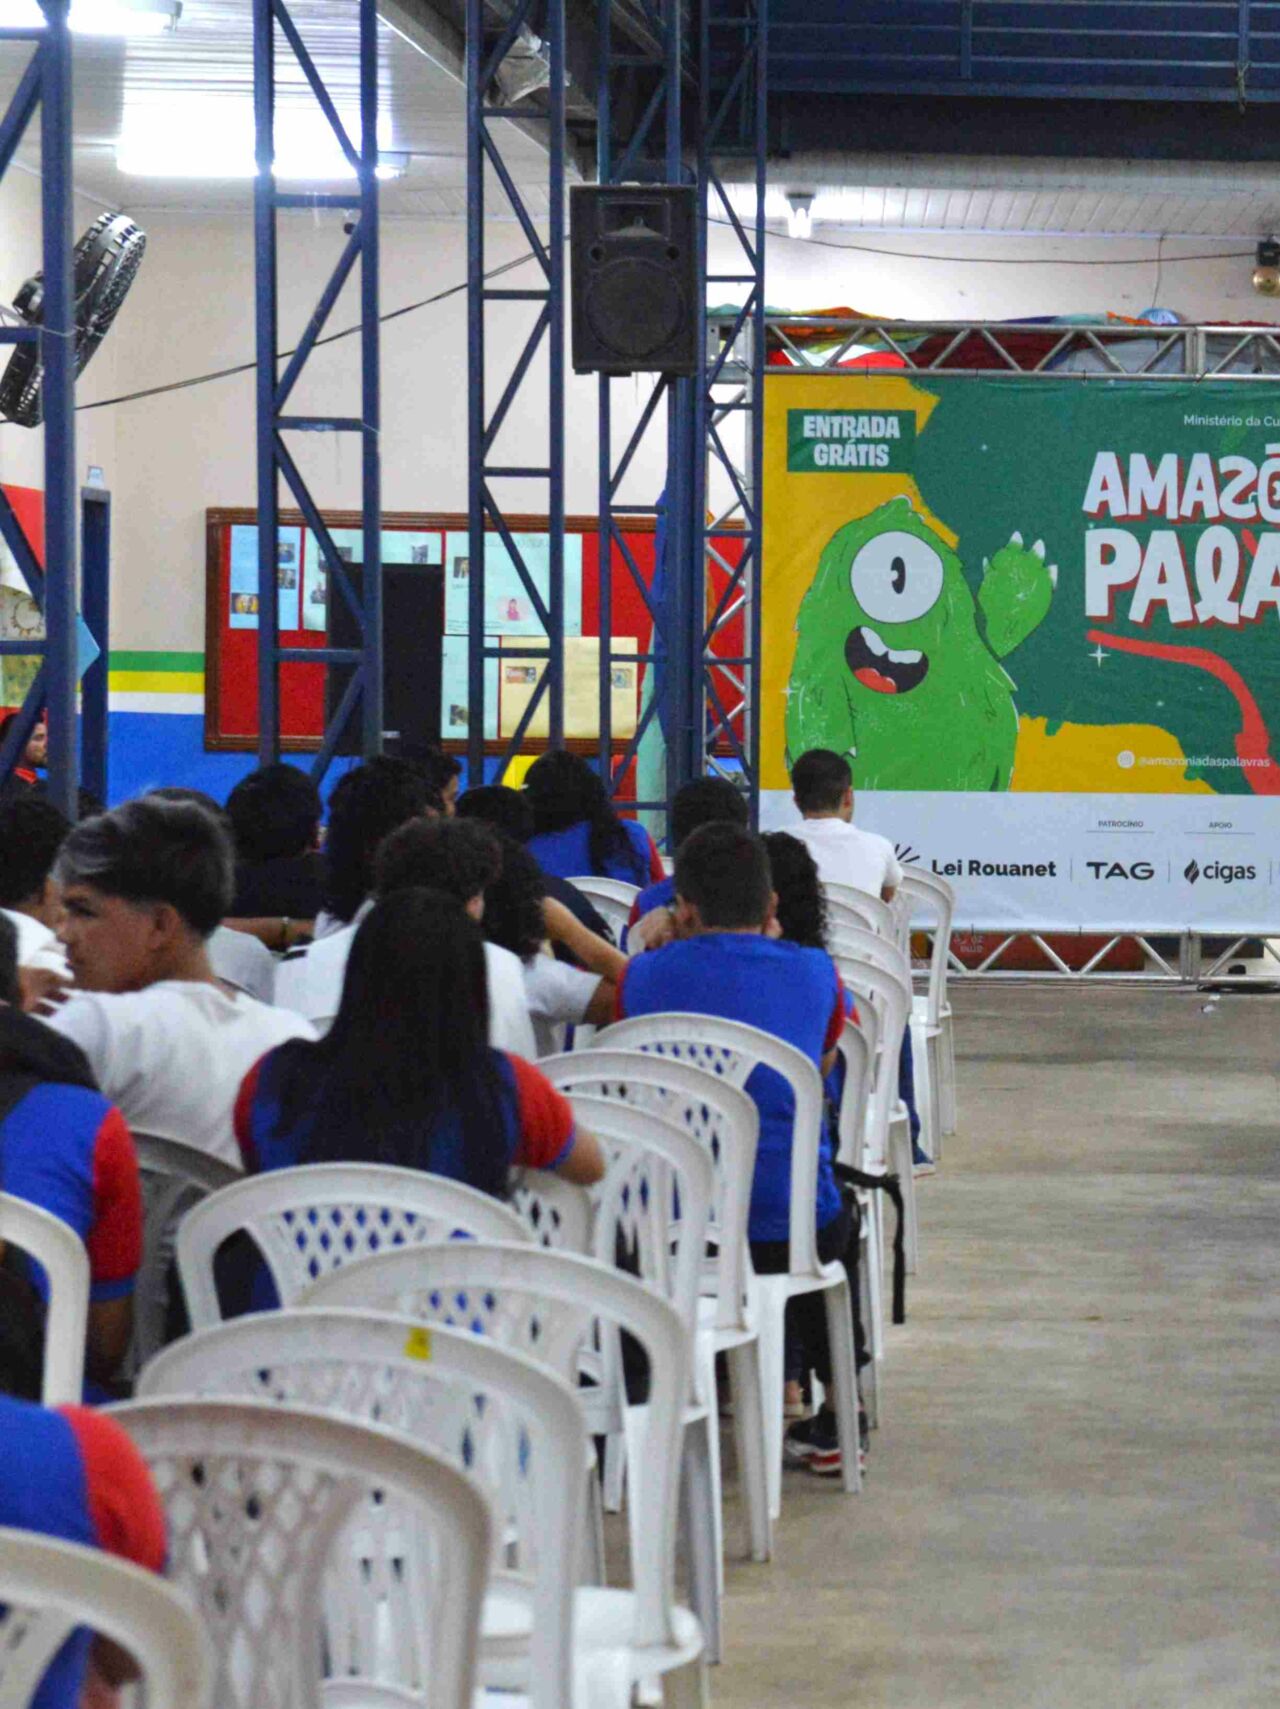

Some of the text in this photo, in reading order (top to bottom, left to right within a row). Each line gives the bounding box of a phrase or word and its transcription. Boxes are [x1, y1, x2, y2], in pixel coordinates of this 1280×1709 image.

[803, 415, 900, 439] ENTRADA
[1183, 415, 1243, 427] Ministério
[1245, 415, 1261, 427] da
[813, 438, 890, 467] GRÁTIS
[1139, 755, 1271, 768] @amazoniadaspalavras
[1209, 821, 1233, 829] APOIO
[931, 859, 1057, 877] Lei Rouanet
[1086, 861, 1155, 880] TAG
[1203, 860, 1256, 884] cigas
